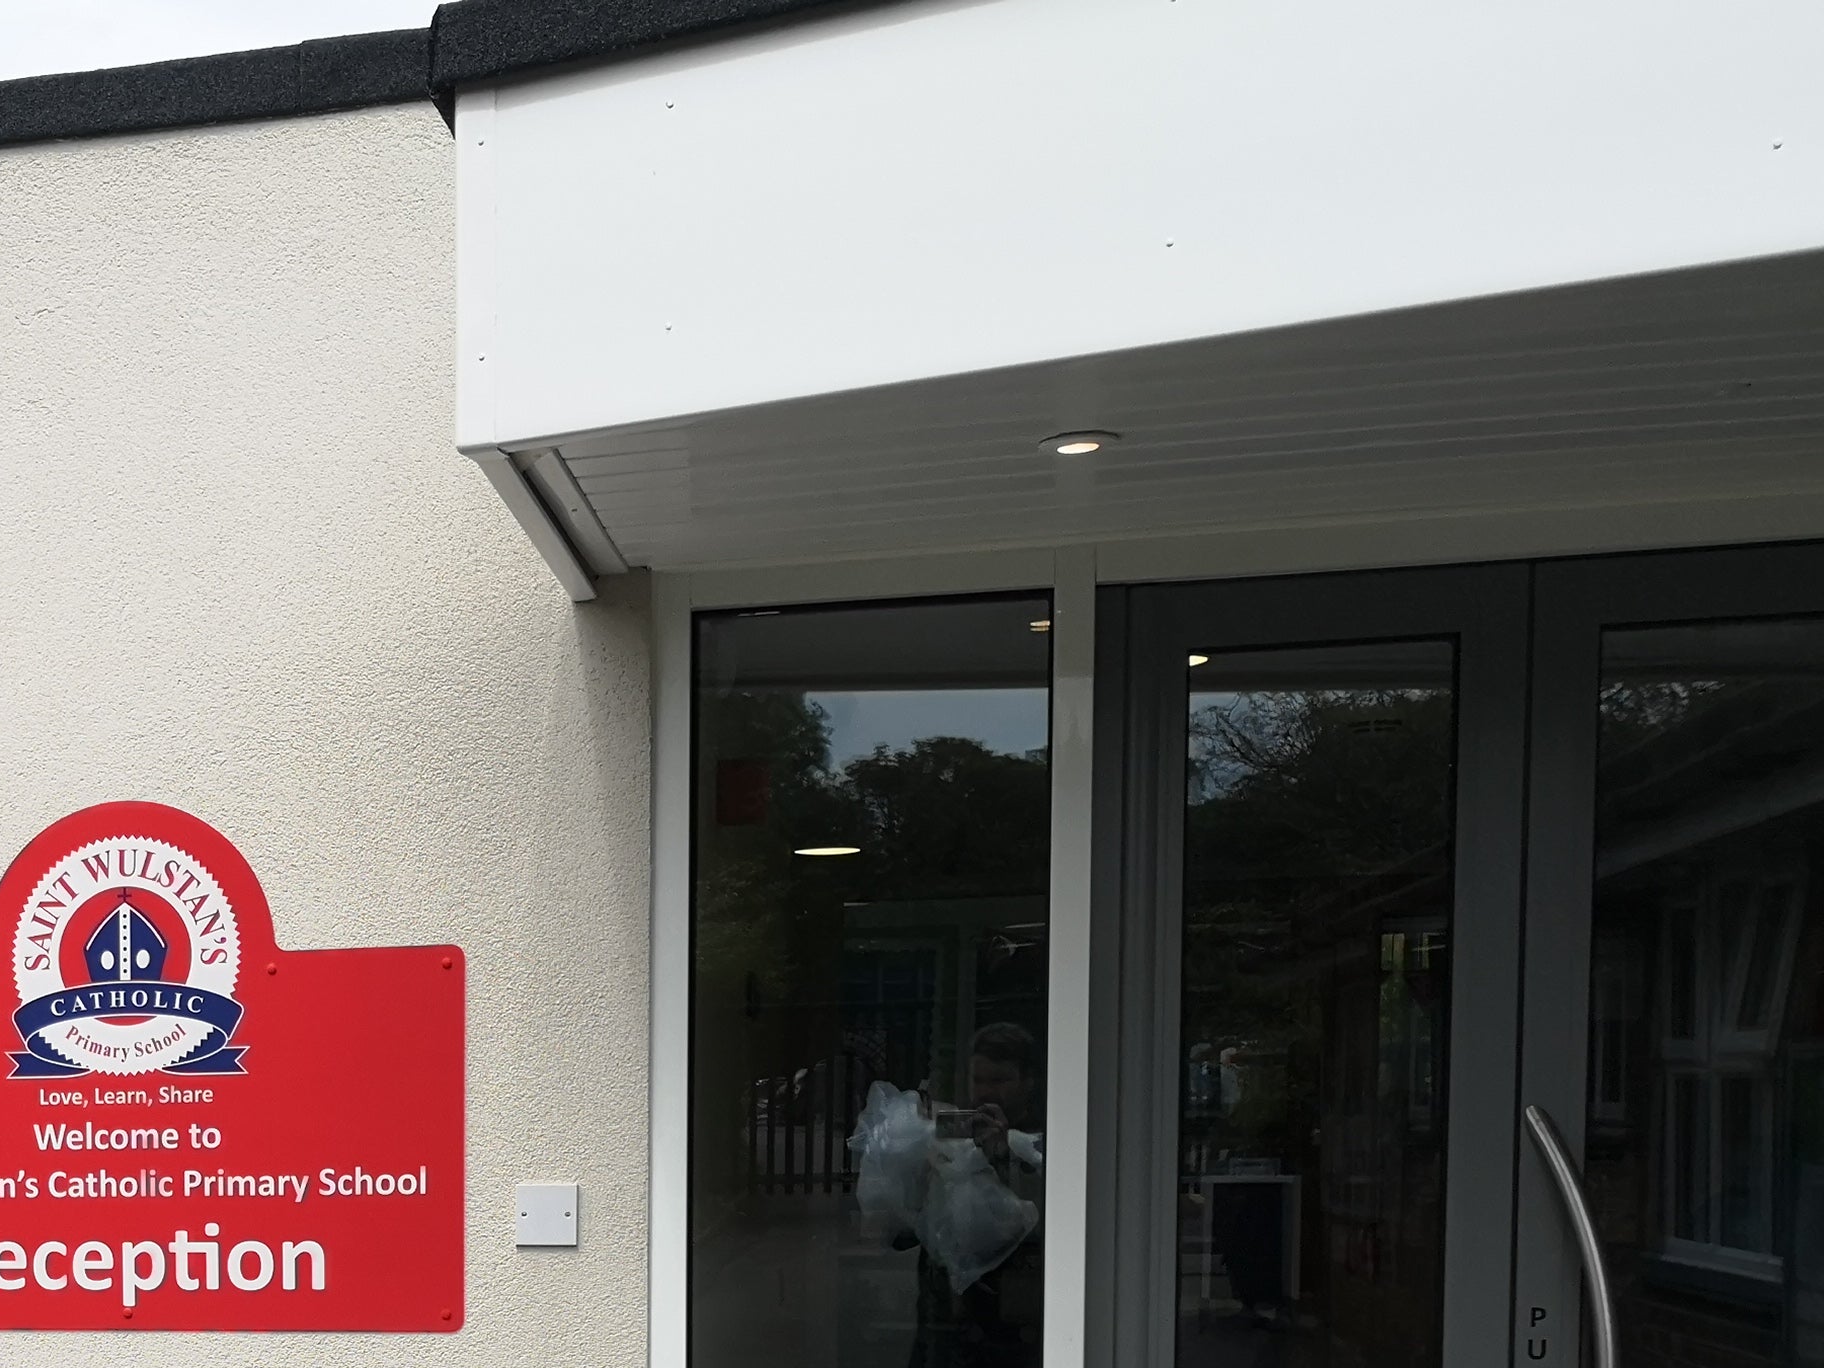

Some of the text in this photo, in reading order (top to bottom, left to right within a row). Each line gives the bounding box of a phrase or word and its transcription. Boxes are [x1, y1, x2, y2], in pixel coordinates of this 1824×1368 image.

[24, 848, 229, 971] SAINT WULSTAN’S
[50, 989, 205, 1017] CATHOLIC
[65, 1023, 187, 1063] Primary School
[39, 1085, 214, 1108] Love, Learn, Share
[33, 1121, 222, 1151] Welcome to
[48, 1169, 174, 1198] Catholic
[183, 1168, 309, 1203] Primary
[318, 1165, 427, 1196] School
